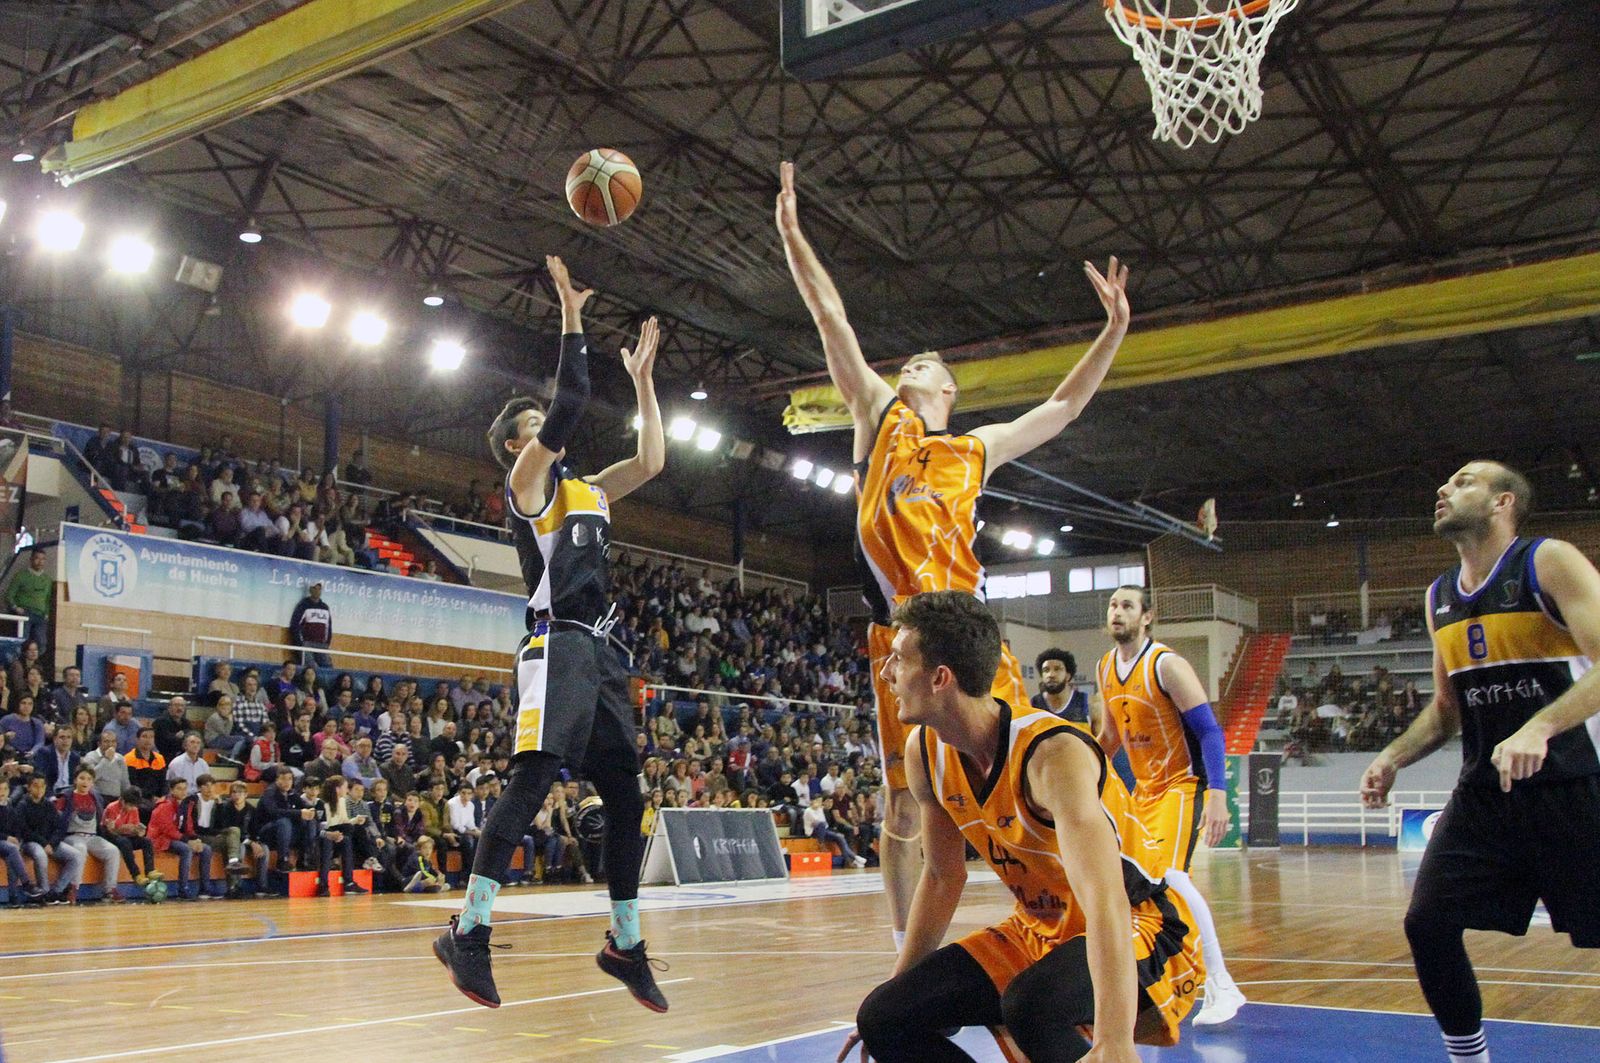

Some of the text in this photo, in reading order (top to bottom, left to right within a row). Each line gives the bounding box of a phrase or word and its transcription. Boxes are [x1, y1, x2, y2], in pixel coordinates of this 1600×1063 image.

[140, 547, 239, 573] Ayuntamiento
[168, 566, 238, 588] de Huelva
[268, 568, 292, 587] La
[1467, 623, 1488, 660] 8
